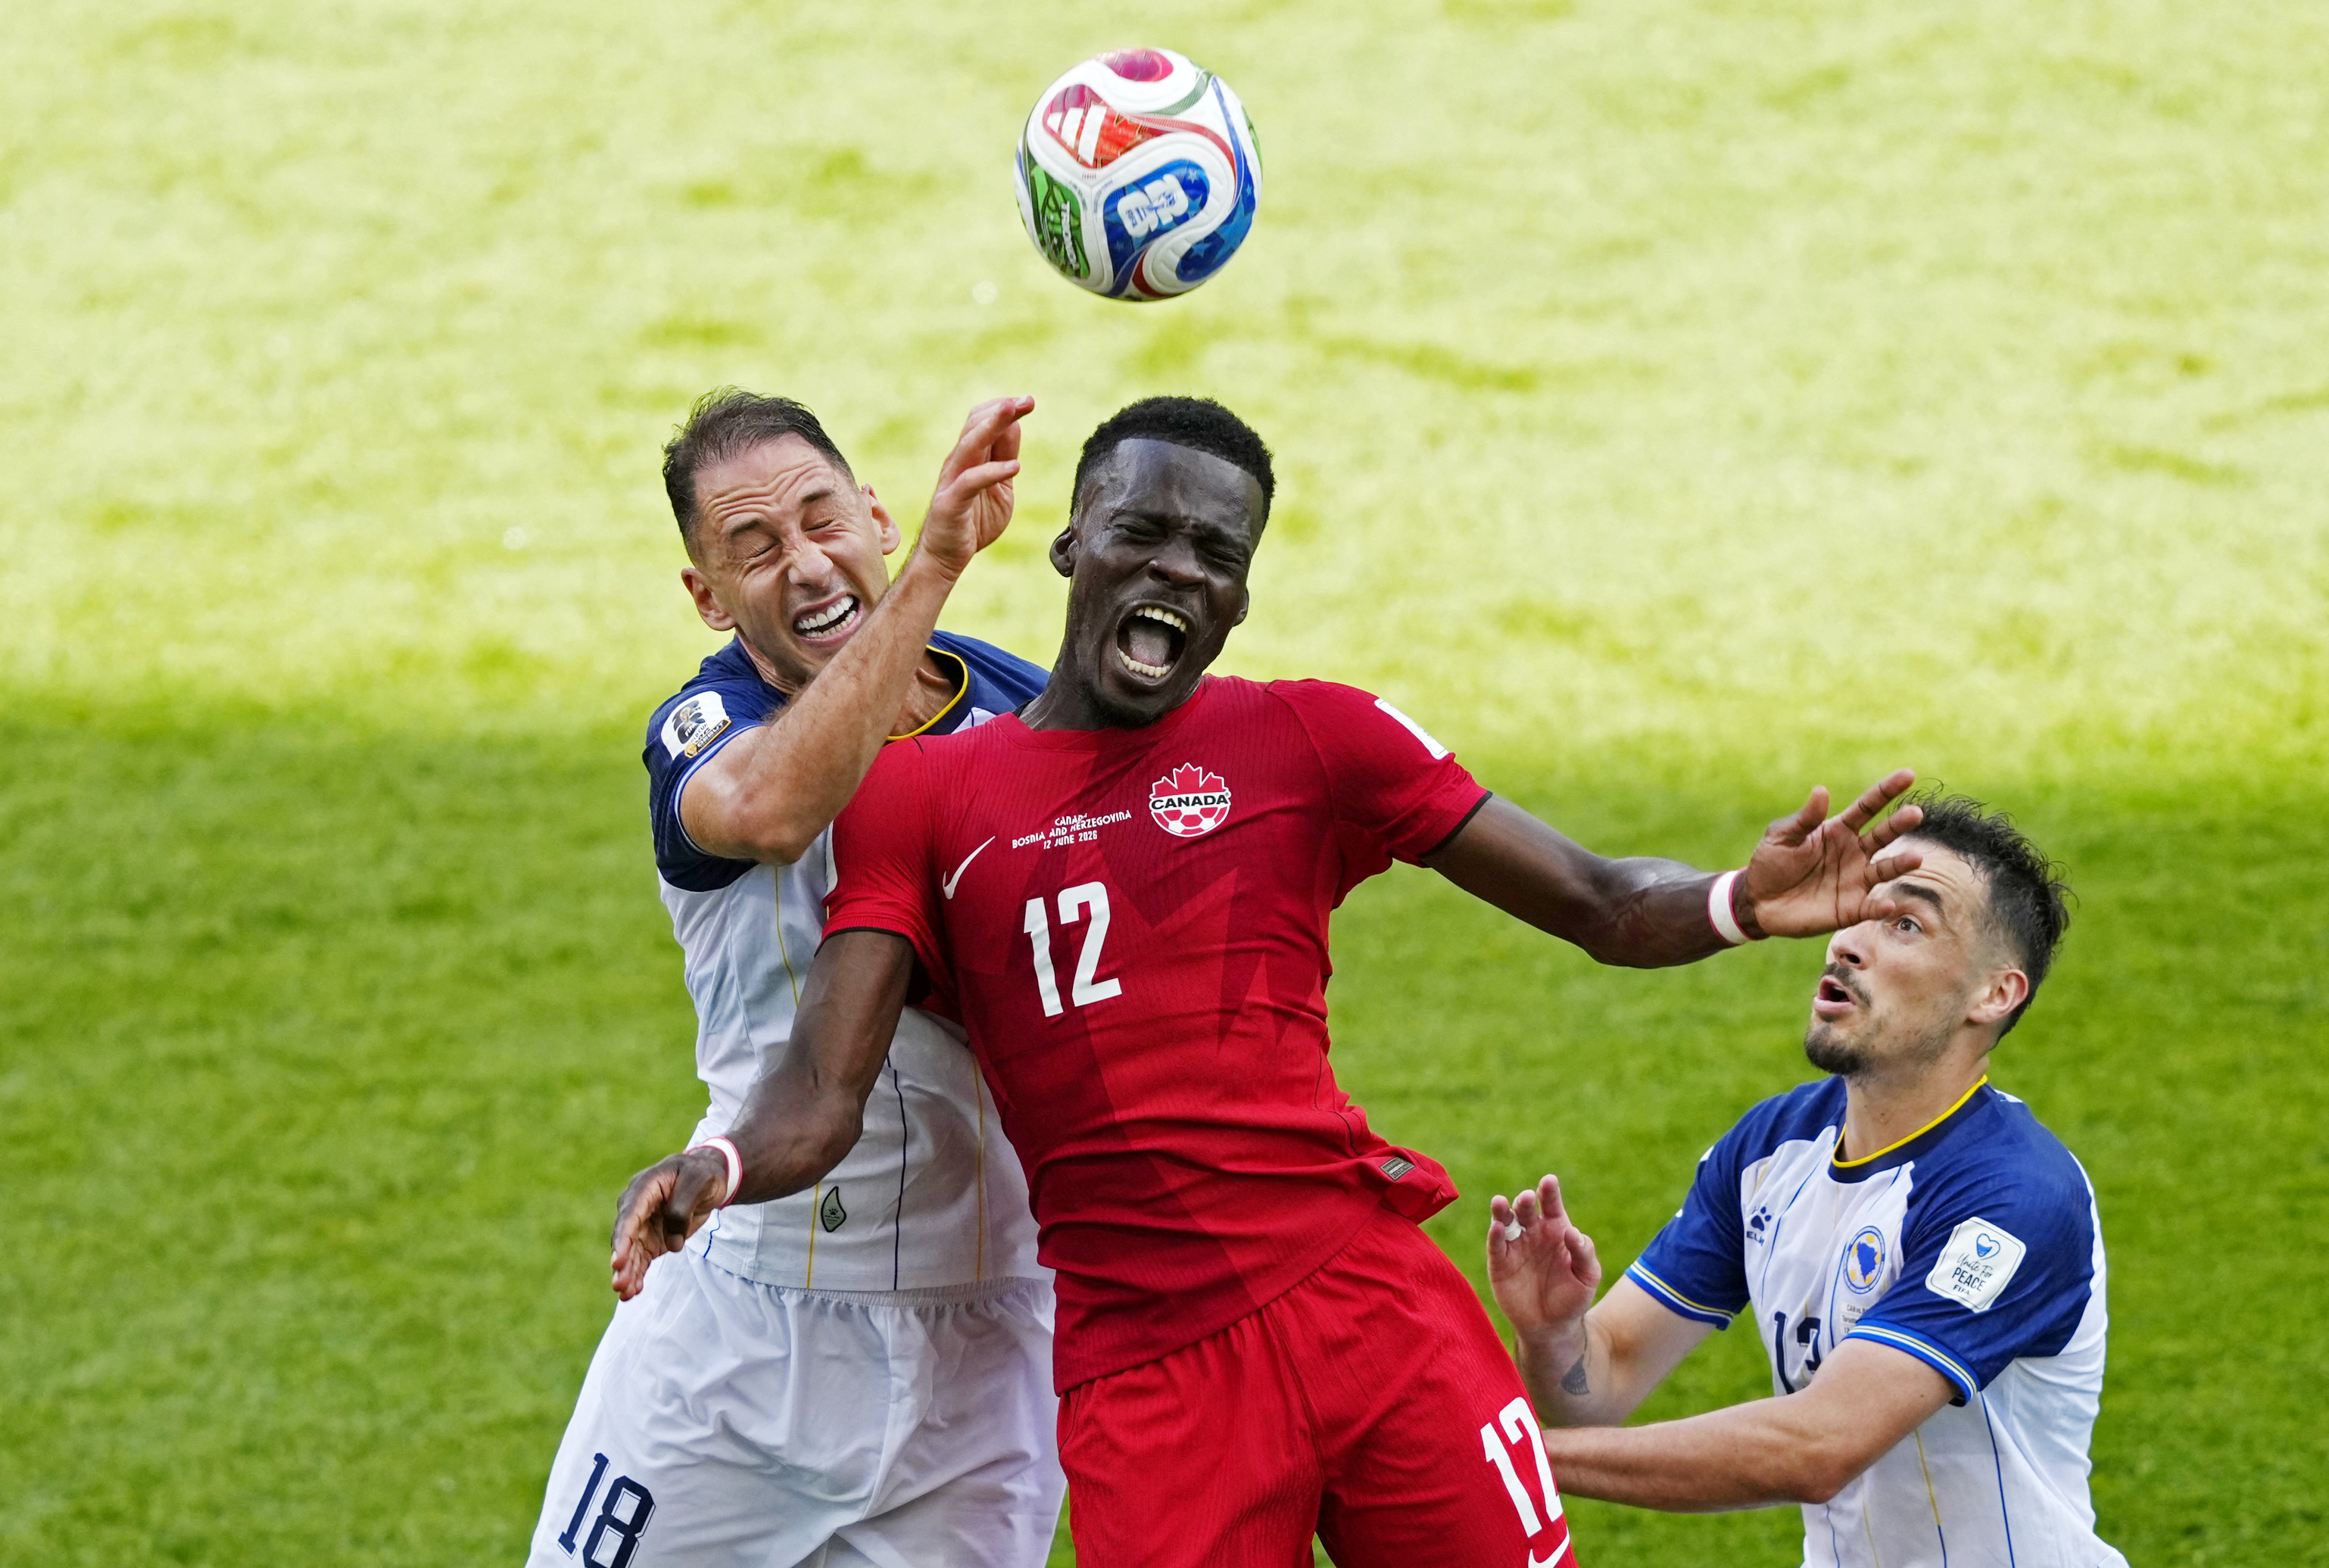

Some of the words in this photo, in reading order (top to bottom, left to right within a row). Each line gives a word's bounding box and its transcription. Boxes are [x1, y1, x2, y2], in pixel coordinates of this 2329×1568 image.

[1151, 794, 1229, 810] CANADA
[1012, 831, 1046, 849] BOSNIA
[1049, 827, 1068, 838] AND
[1070, 809, 1132, 832] HERZEGOVINA
[1043, 840, 1052, 849] 12
[1054, 834, 1074, 847] JUNE
[1078, 830, 1098, 843] 2026
[1024, 881, 1122, 1017] 12
[1956, 1252, 1980, 1272] Unite
[1979, 1265, 1993, 1278] For
[1952, 1267, 1986, 1292] PEACE
[1953, 1285, 1970, 1295] FIFA
[1480, 1396, 1563, 1538] 12
[557, 1452, 656, 1568] 18
